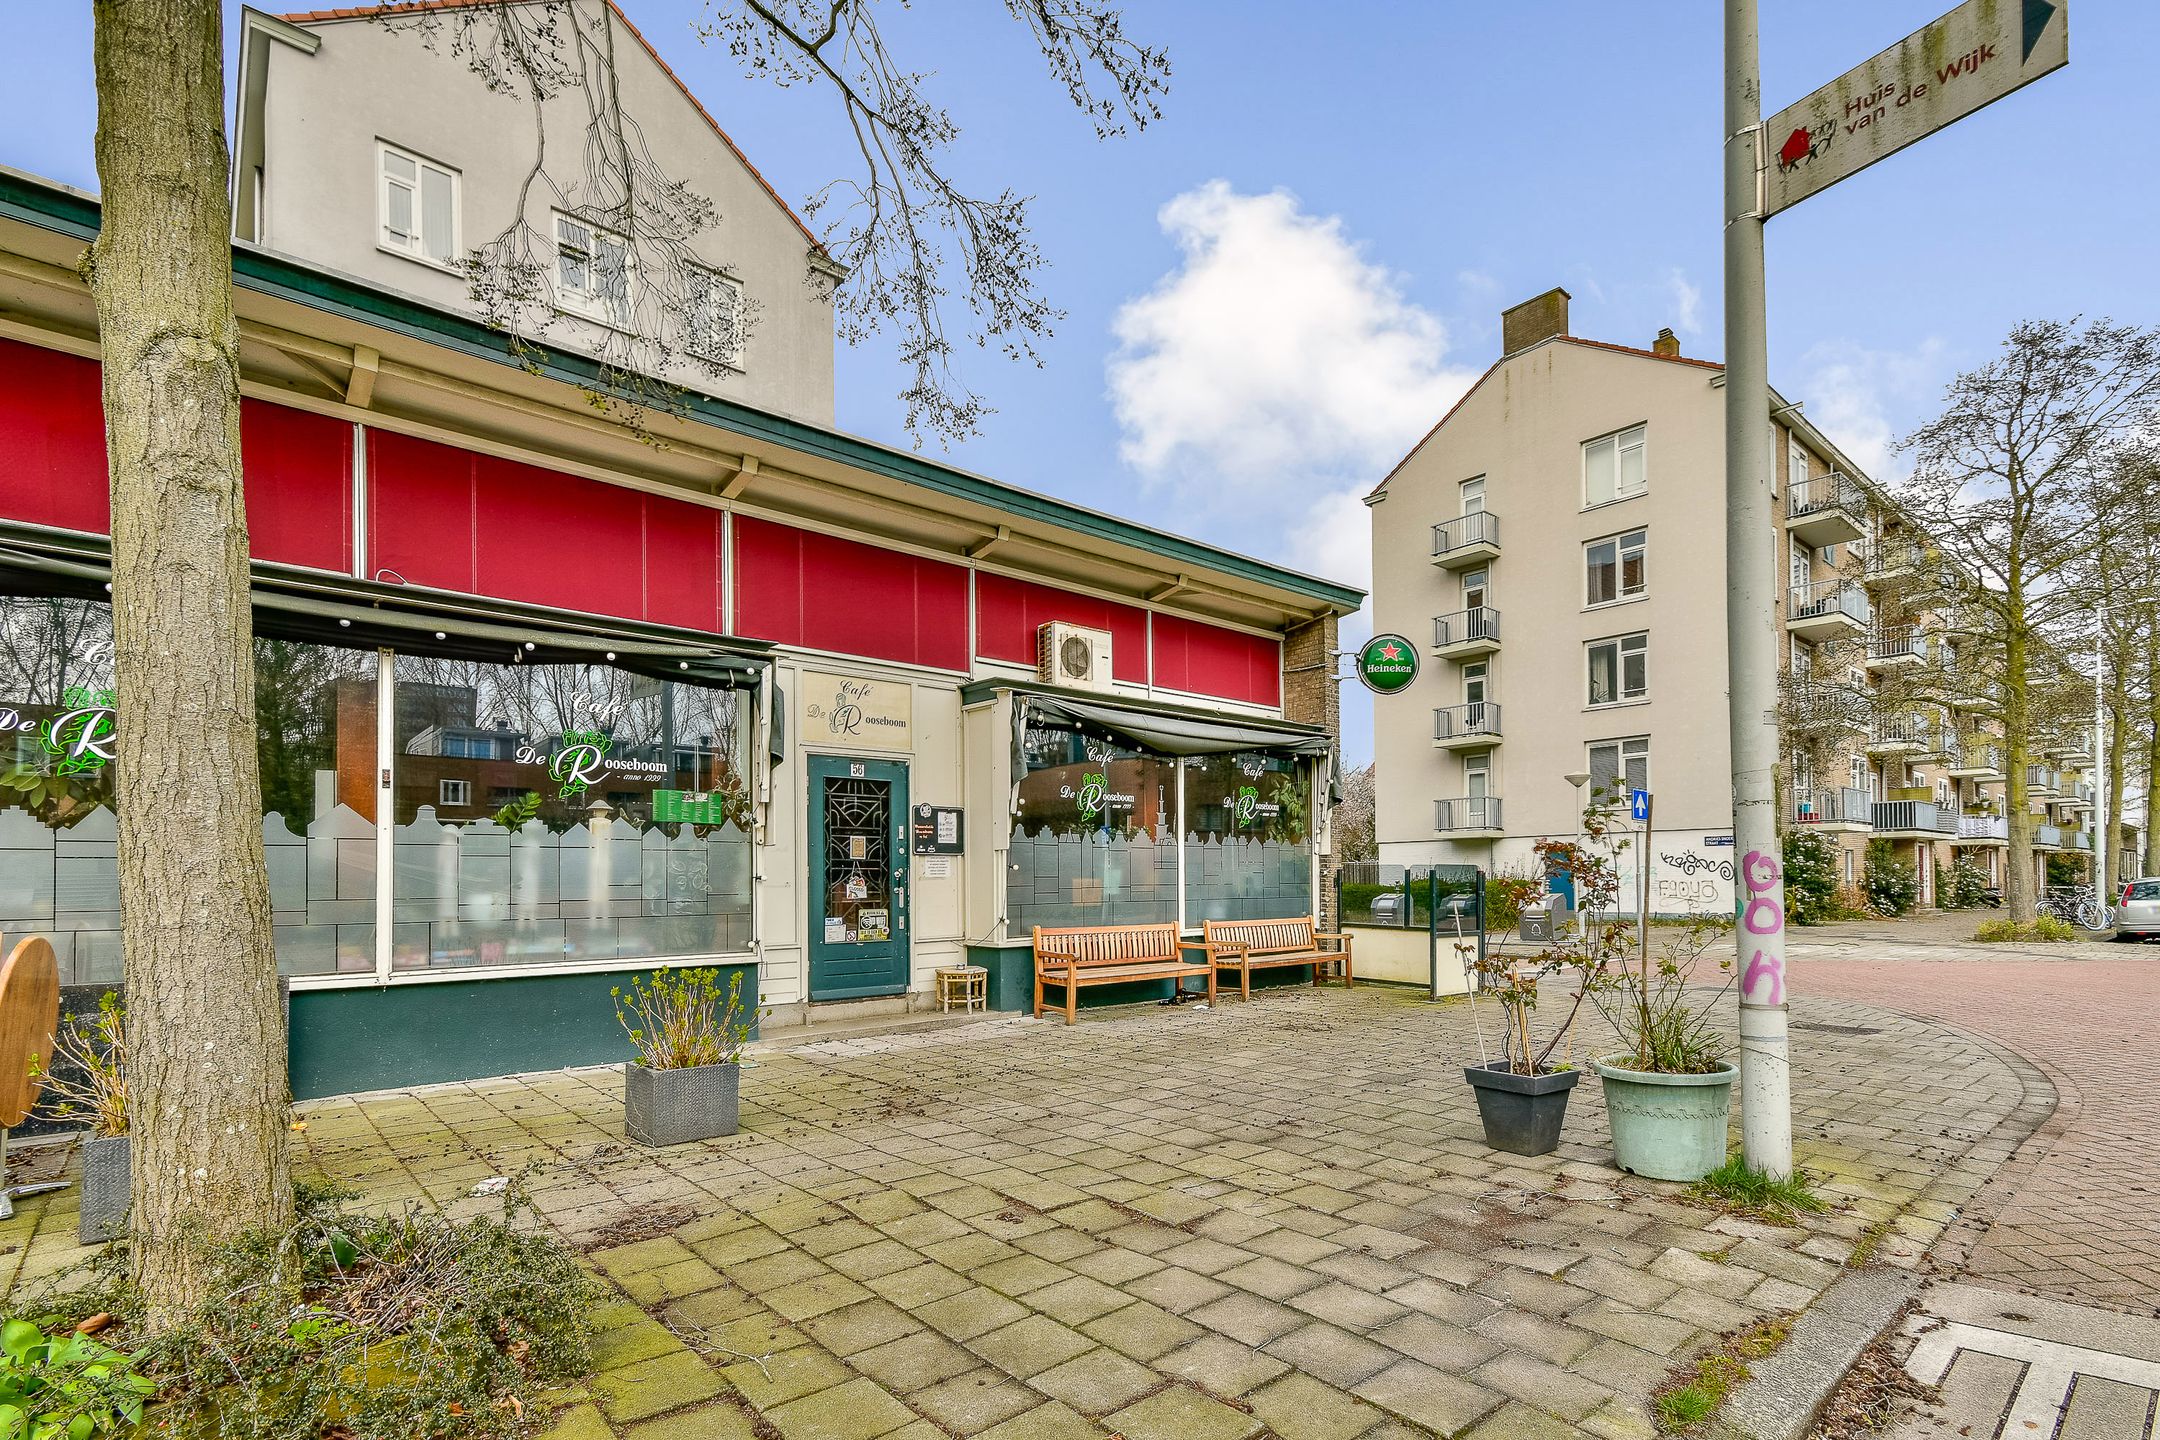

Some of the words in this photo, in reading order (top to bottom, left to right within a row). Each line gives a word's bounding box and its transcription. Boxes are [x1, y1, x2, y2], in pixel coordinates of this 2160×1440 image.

[1844, 105, 1886, 135] van
[1896, 83, 1928, 108] de
[1936, 43, 1997, 85] Wijk
[1844, 81, 1896, 119] Huis
[1367, 663, 1413, 673] Heineken
[840, 680, 874, 700] Café
[570, 691, 628, 722] Café
[807, 704, 826, 718] De
[515, 744, 546, 765] De
[1086, 746, 1115, 767] Café
[853, 764, 863, 775] 56
[1242, 763, 1265, 781] Café
[1060, 785, 1076, 799] De
[1223, 796, 1235, 808] De
